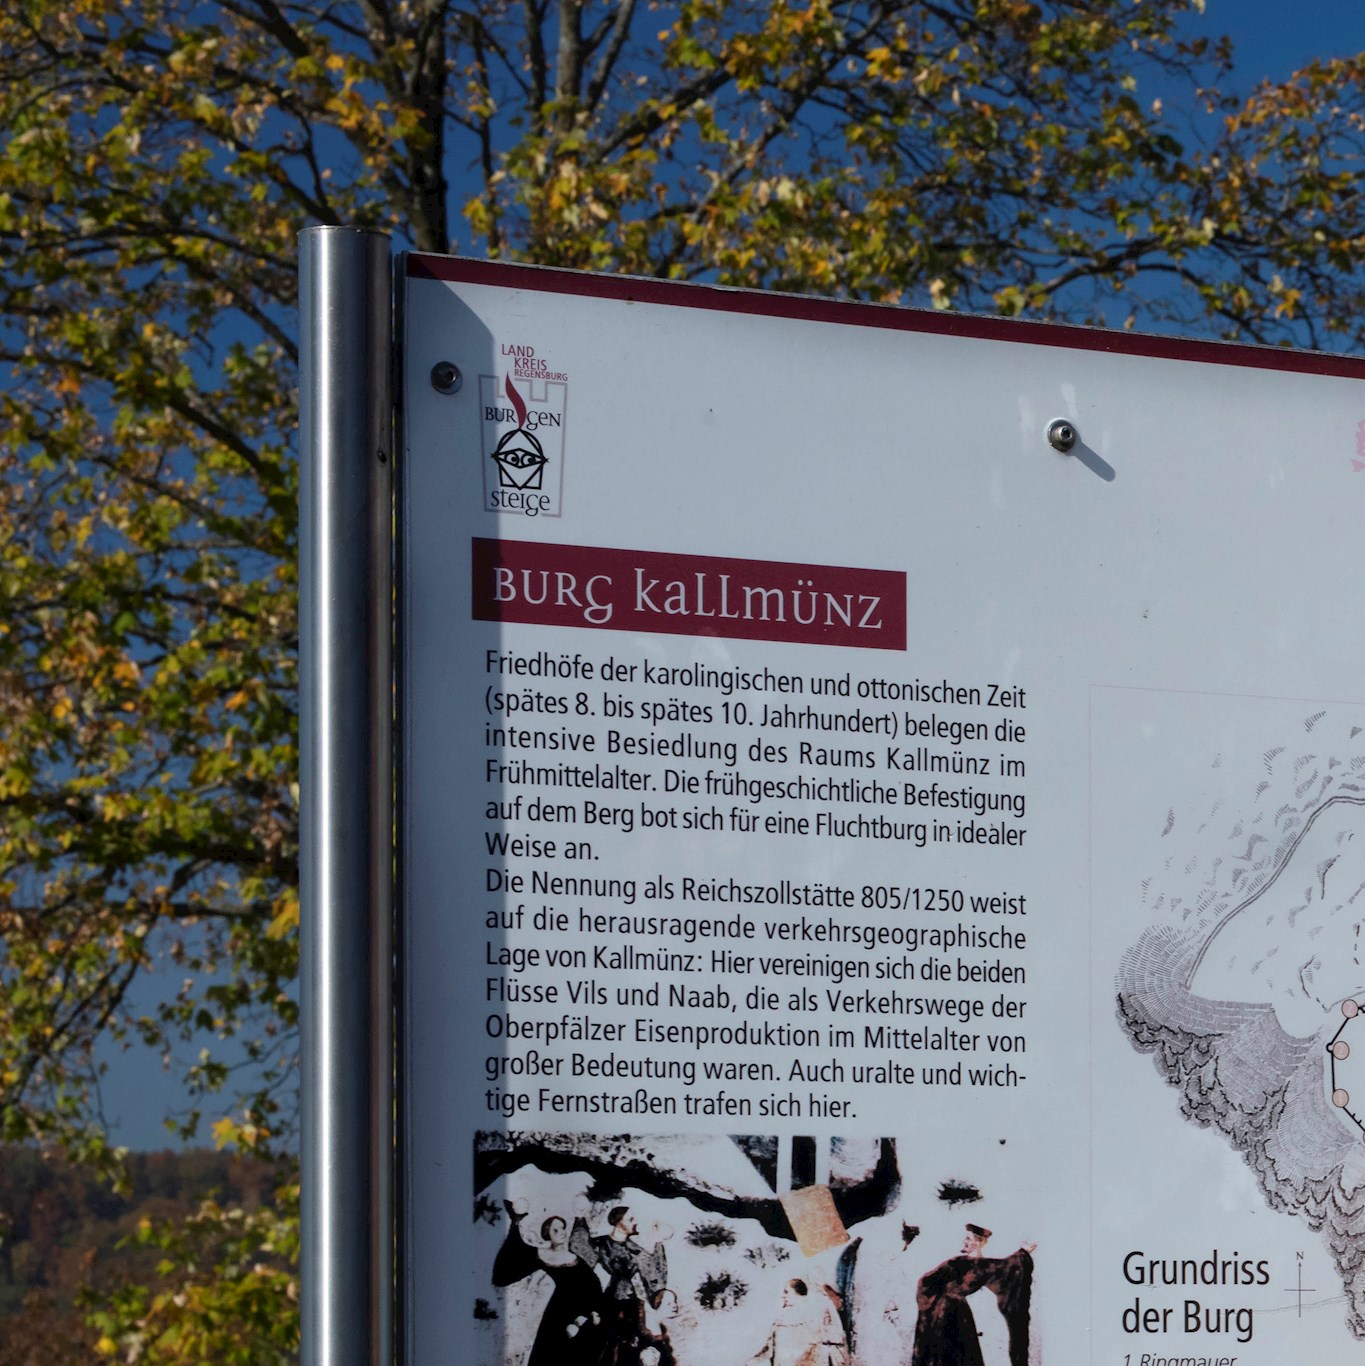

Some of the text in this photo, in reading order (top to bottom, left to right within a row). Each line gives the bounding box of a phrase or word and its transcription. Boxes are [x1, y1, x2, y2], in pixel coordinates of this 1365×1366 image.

[502, 344, 535, 358] LAND
[514, 357, 547, 370] KREIS
[514, 368, 568, 381] REGENSBURG
[486, 649, 1026, 709] Friedhöfe der karolingischen und ottonischen Zeit
[485, 686, 1026, 745] (spätes 8. bis spätes 10. Jahrhundert) belegen die
[484, 833, 599, 860] Weise an.
[486, 868, 1027, 915] Die Nennung als Reichszollstätte 805/1250 weist
[485, 1015, 1025, 1053] Oberpfälzer Eisenproduktion im Mittelalter von
[1122, 1249, 1270, 1285] Grundriss
[1122, 1297, 1253, 1343] der Burg
